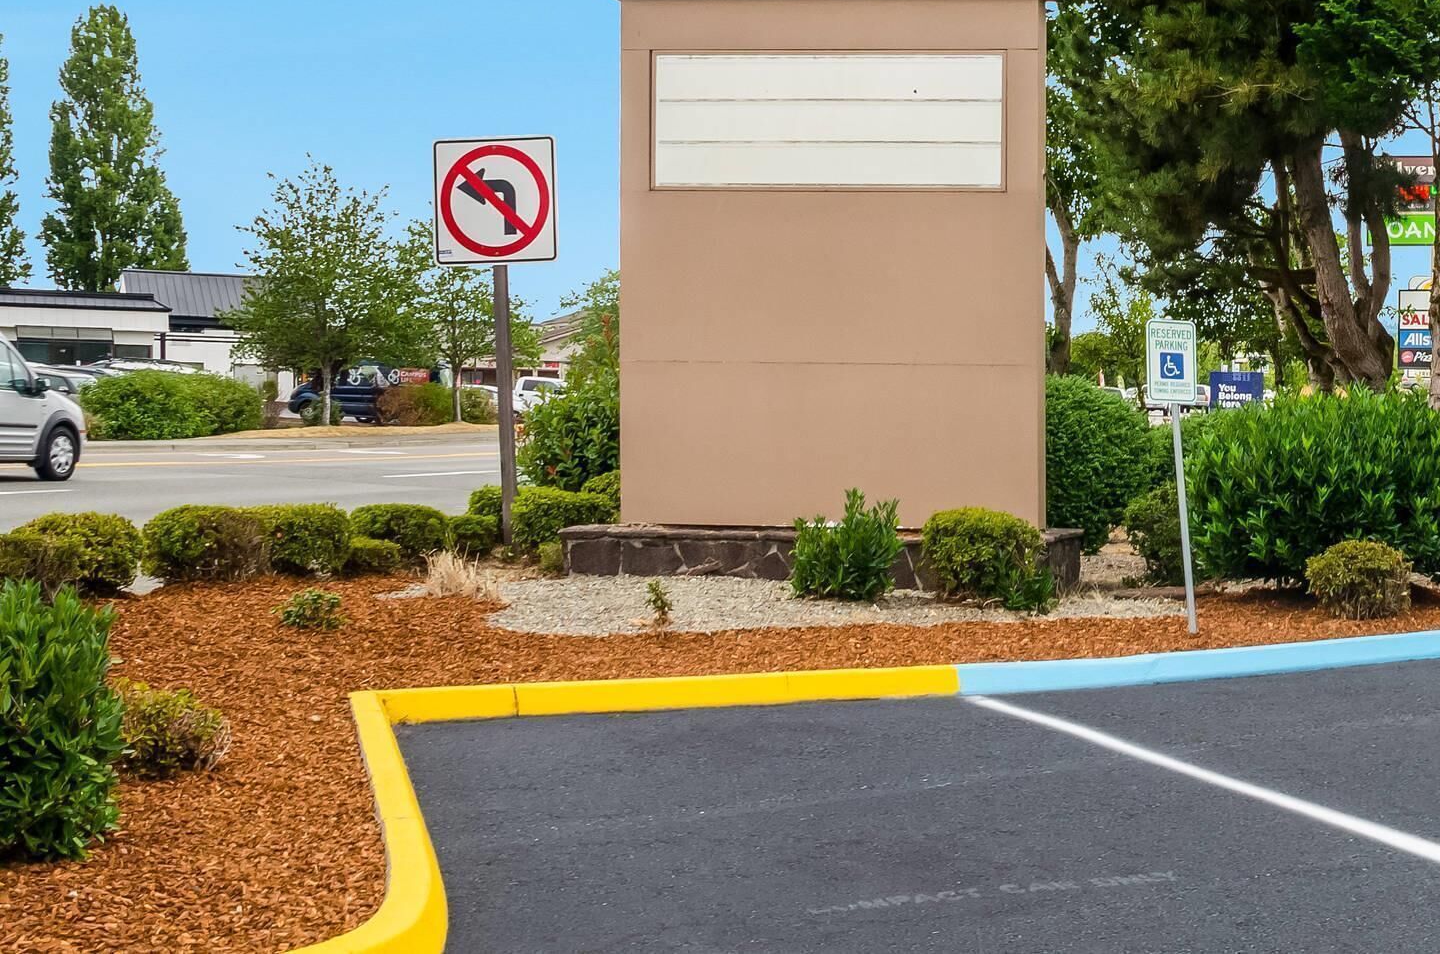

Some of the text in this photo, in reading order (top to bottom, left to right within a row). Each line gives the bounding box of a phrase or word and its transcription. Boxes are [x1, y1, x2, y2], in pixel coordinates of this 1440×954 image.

[1151, 328, 1192, 340] RESERVED
[1155, 340, 1188, 352] PARKING
[1413, 351, 1433, 363] Pizz
[1218, 383, 1237, 392] You
[1218, 392, 1252, 402] Belong
